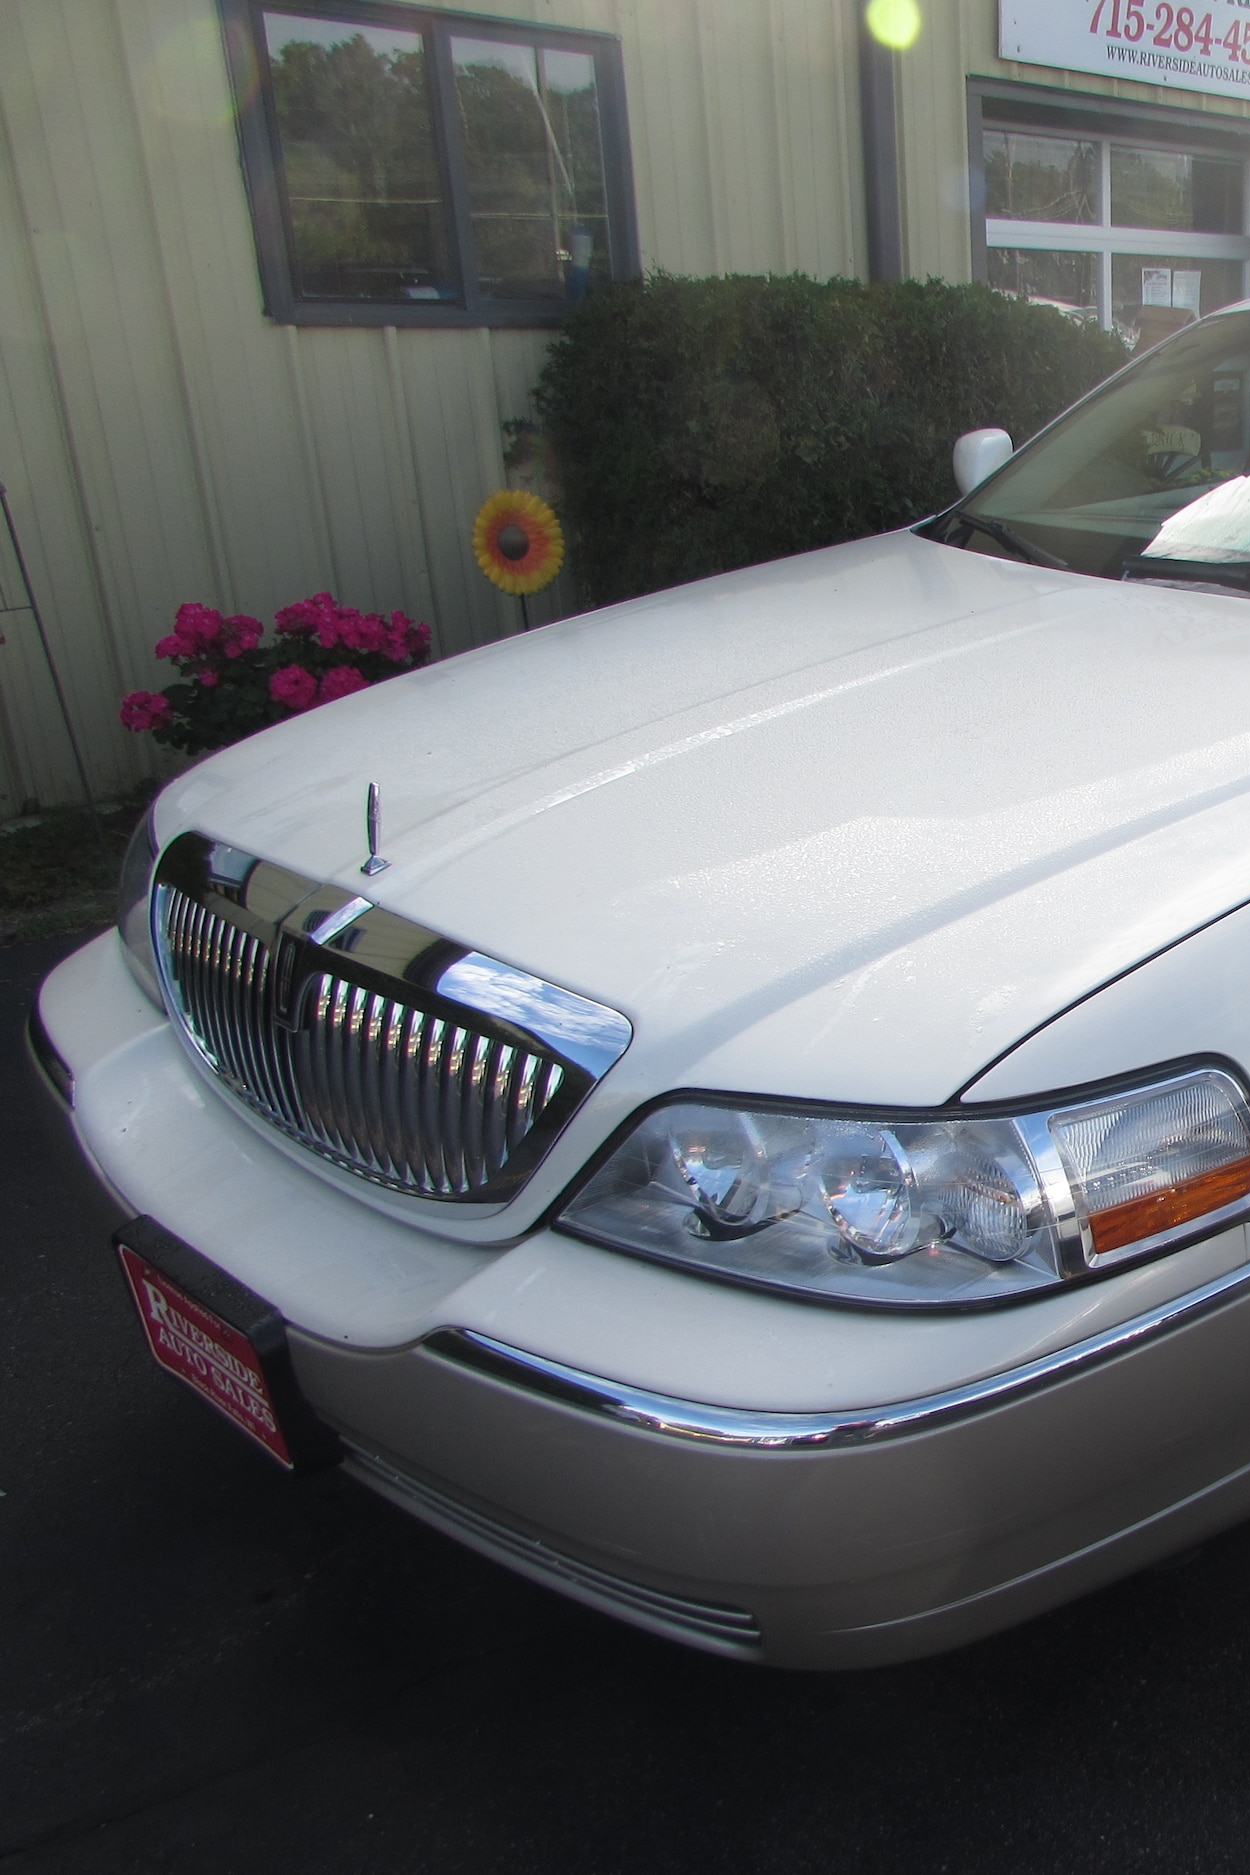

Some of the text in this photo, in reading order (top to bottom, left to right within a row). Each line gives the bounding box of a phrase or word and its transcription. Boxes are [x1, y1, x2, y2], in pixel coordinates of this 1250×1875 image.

[142, 1278, 264, 1395] RIVERSIDE
[159, 1327, 208, 1376] AUTO
[211, 1367, 277, 1433] SALES
